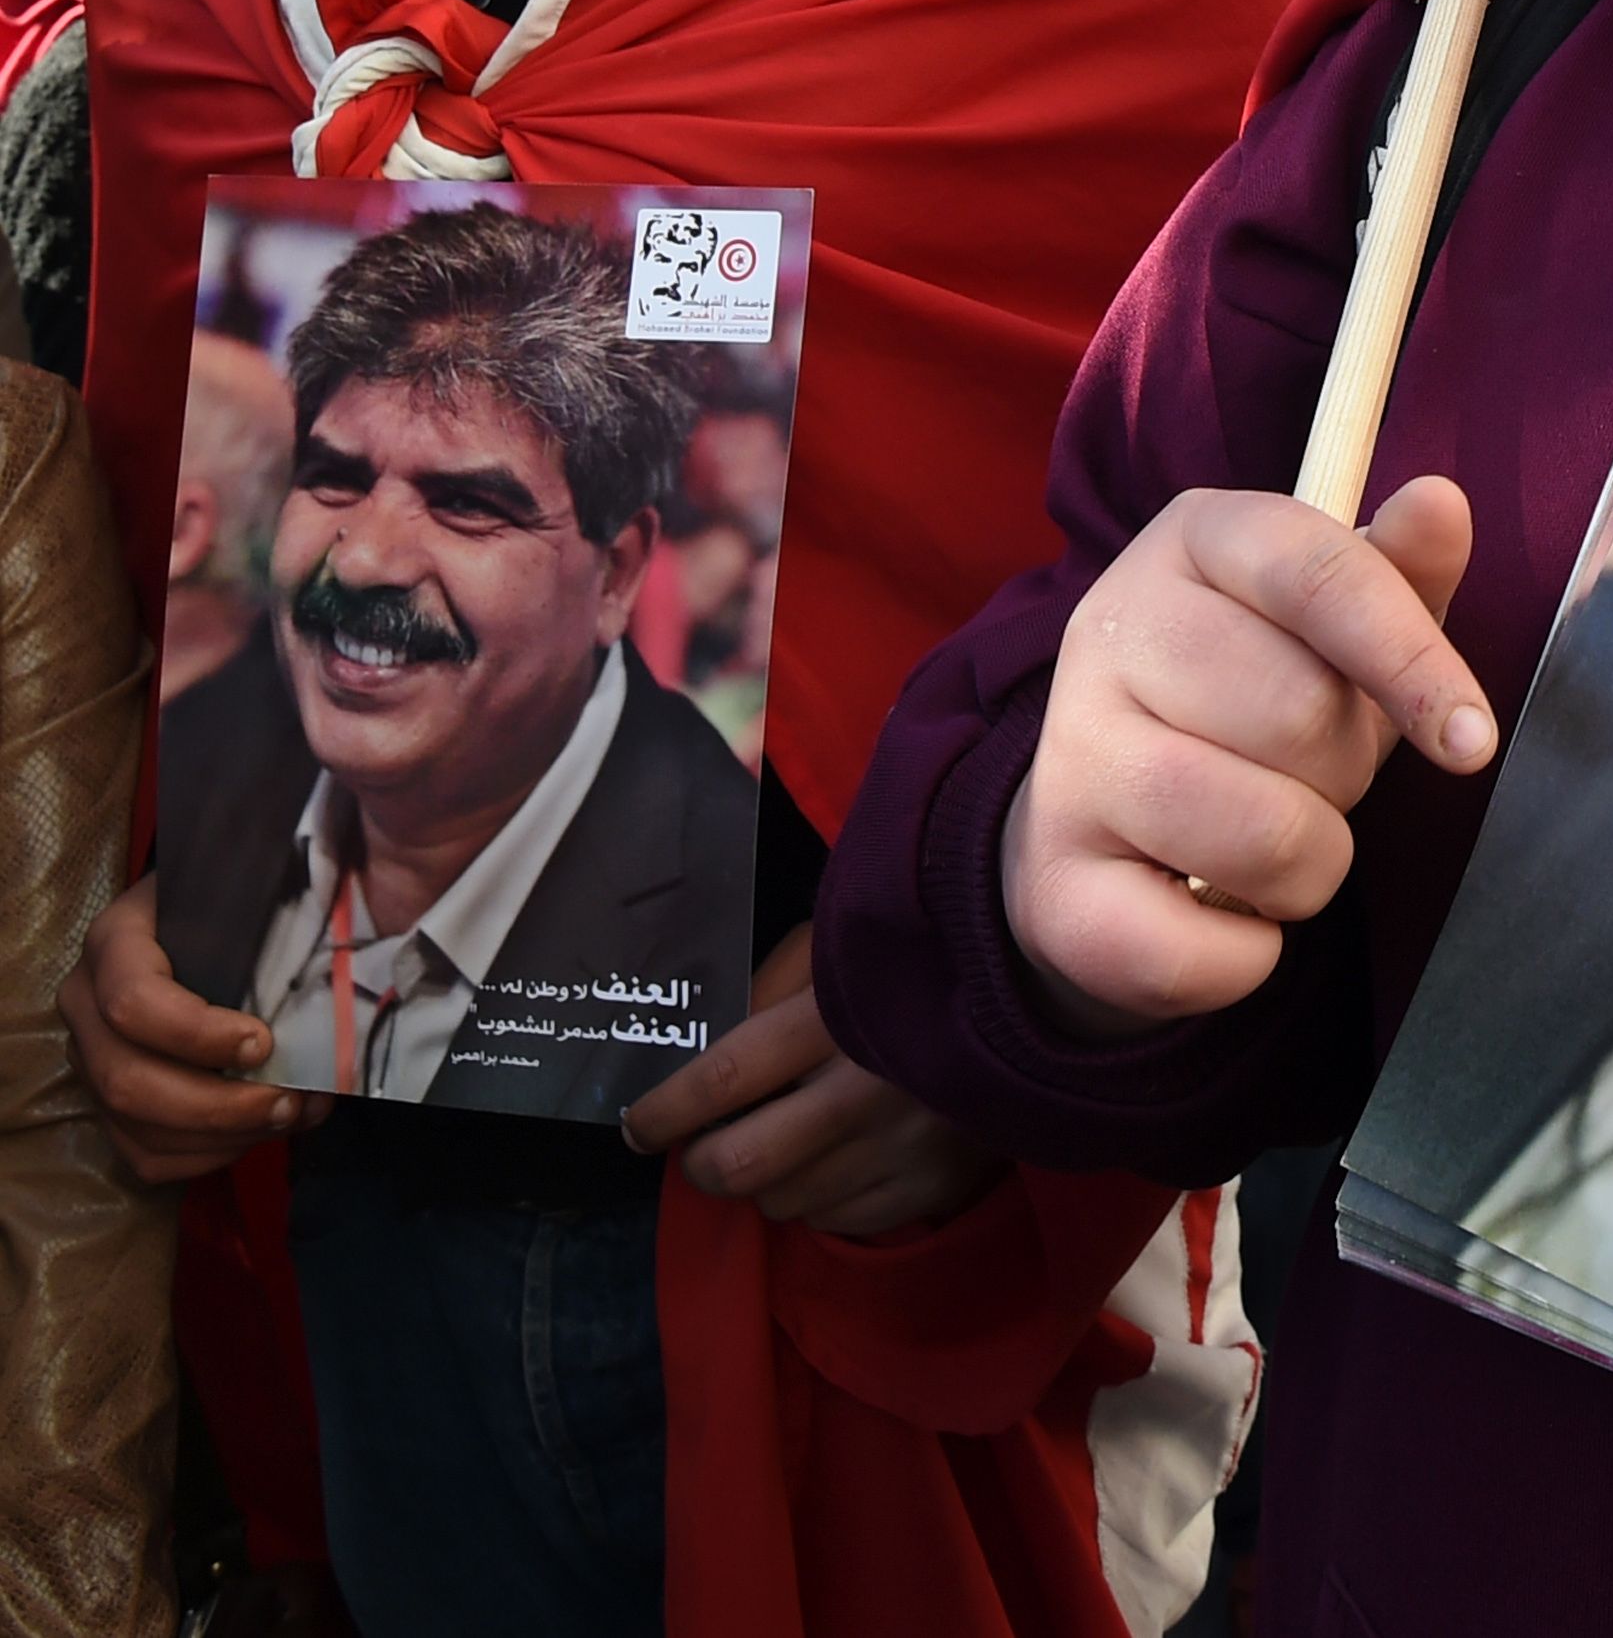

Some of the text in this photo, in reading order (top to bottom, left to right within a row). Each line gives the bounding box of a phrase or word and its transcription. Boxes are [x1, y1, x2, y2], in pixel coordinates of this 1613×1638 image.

[525, 980, 570, 1002] وطن
[572, 983, 588, 1000] لا
[556, 1024, 608, 1042] مدمر
[610, 1013, 708, 1052] العنف
[450, 1050, 540, 1068] محمد براهمي
